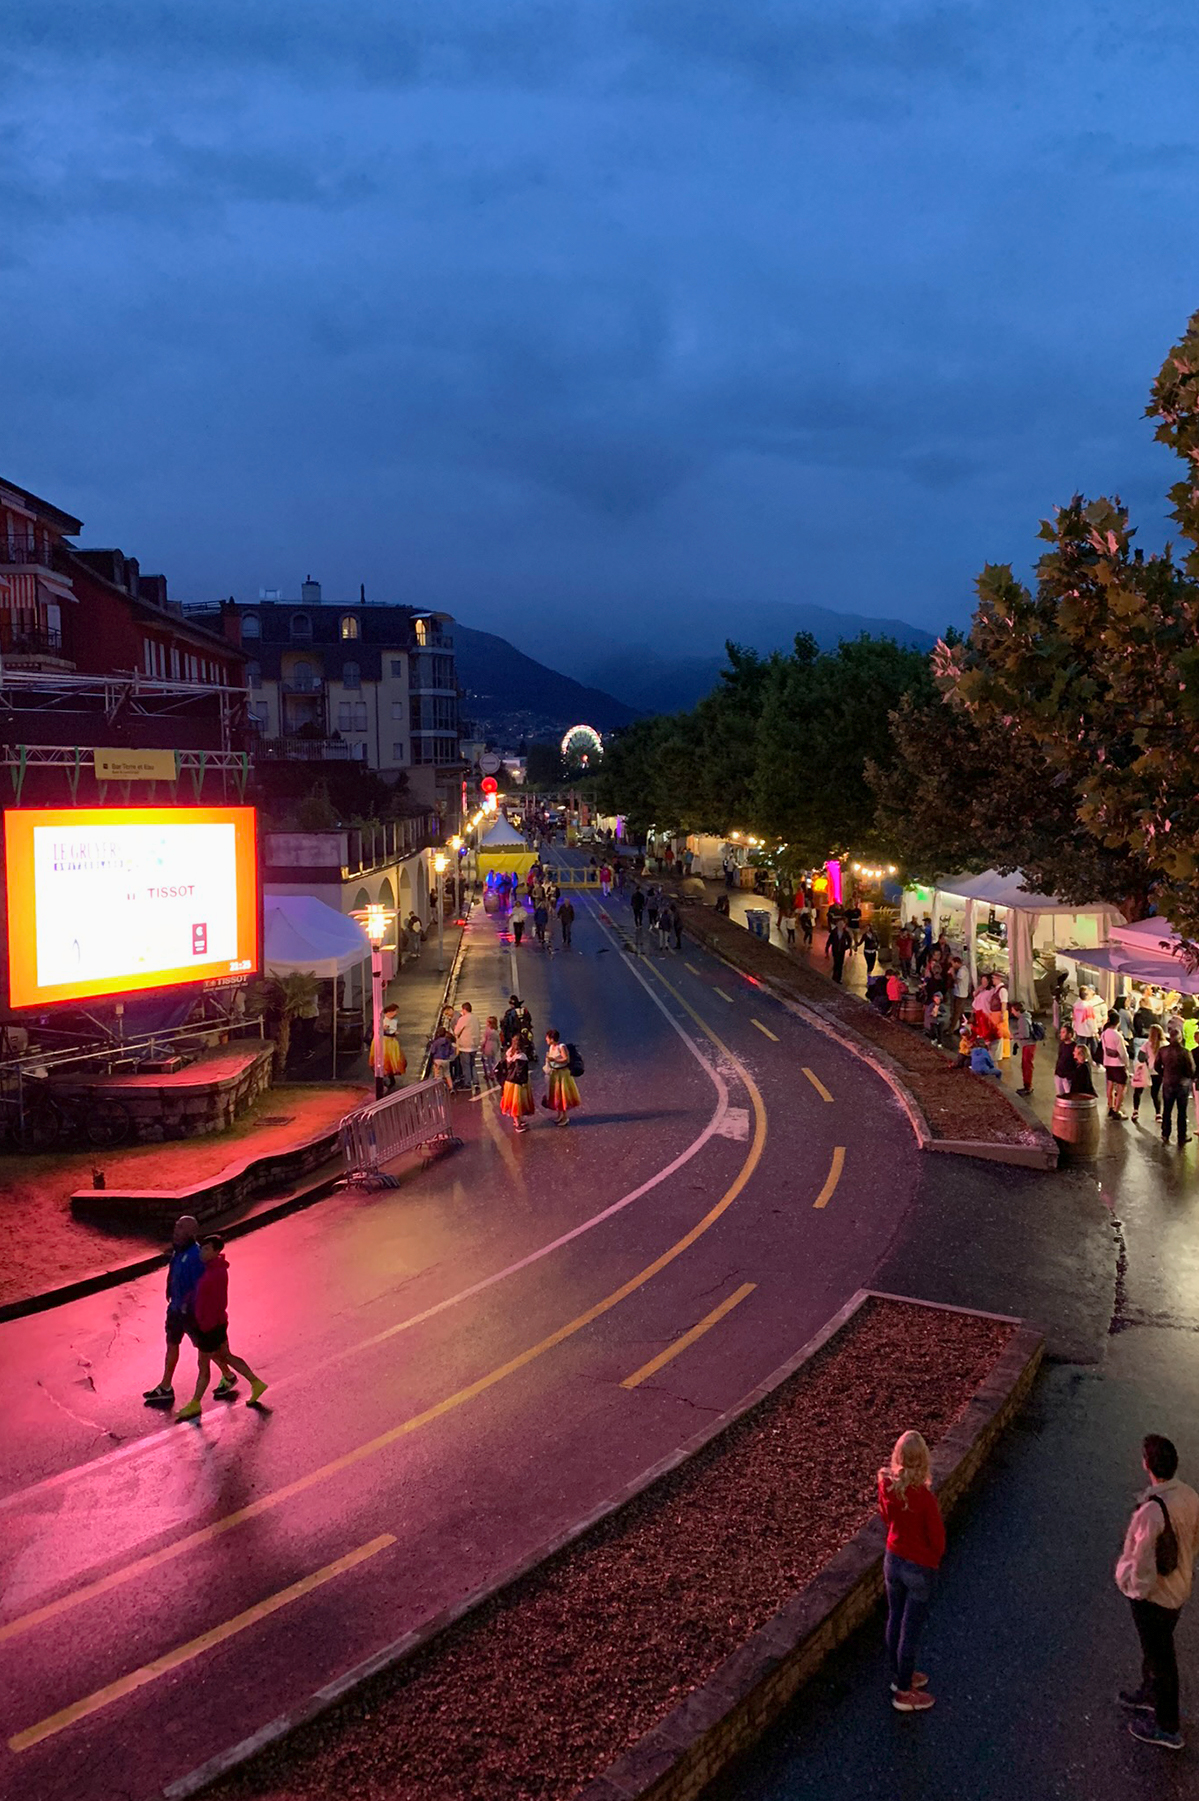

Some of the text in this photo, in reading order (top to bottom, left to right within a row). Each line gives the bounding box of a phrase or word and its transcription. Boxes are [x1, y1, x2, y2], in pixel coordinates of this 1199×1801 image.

[53, 843, 66, 860] LE
[147, 885, 195, 899] TISSOT
[217, 974, 247, 985] TISSOT
